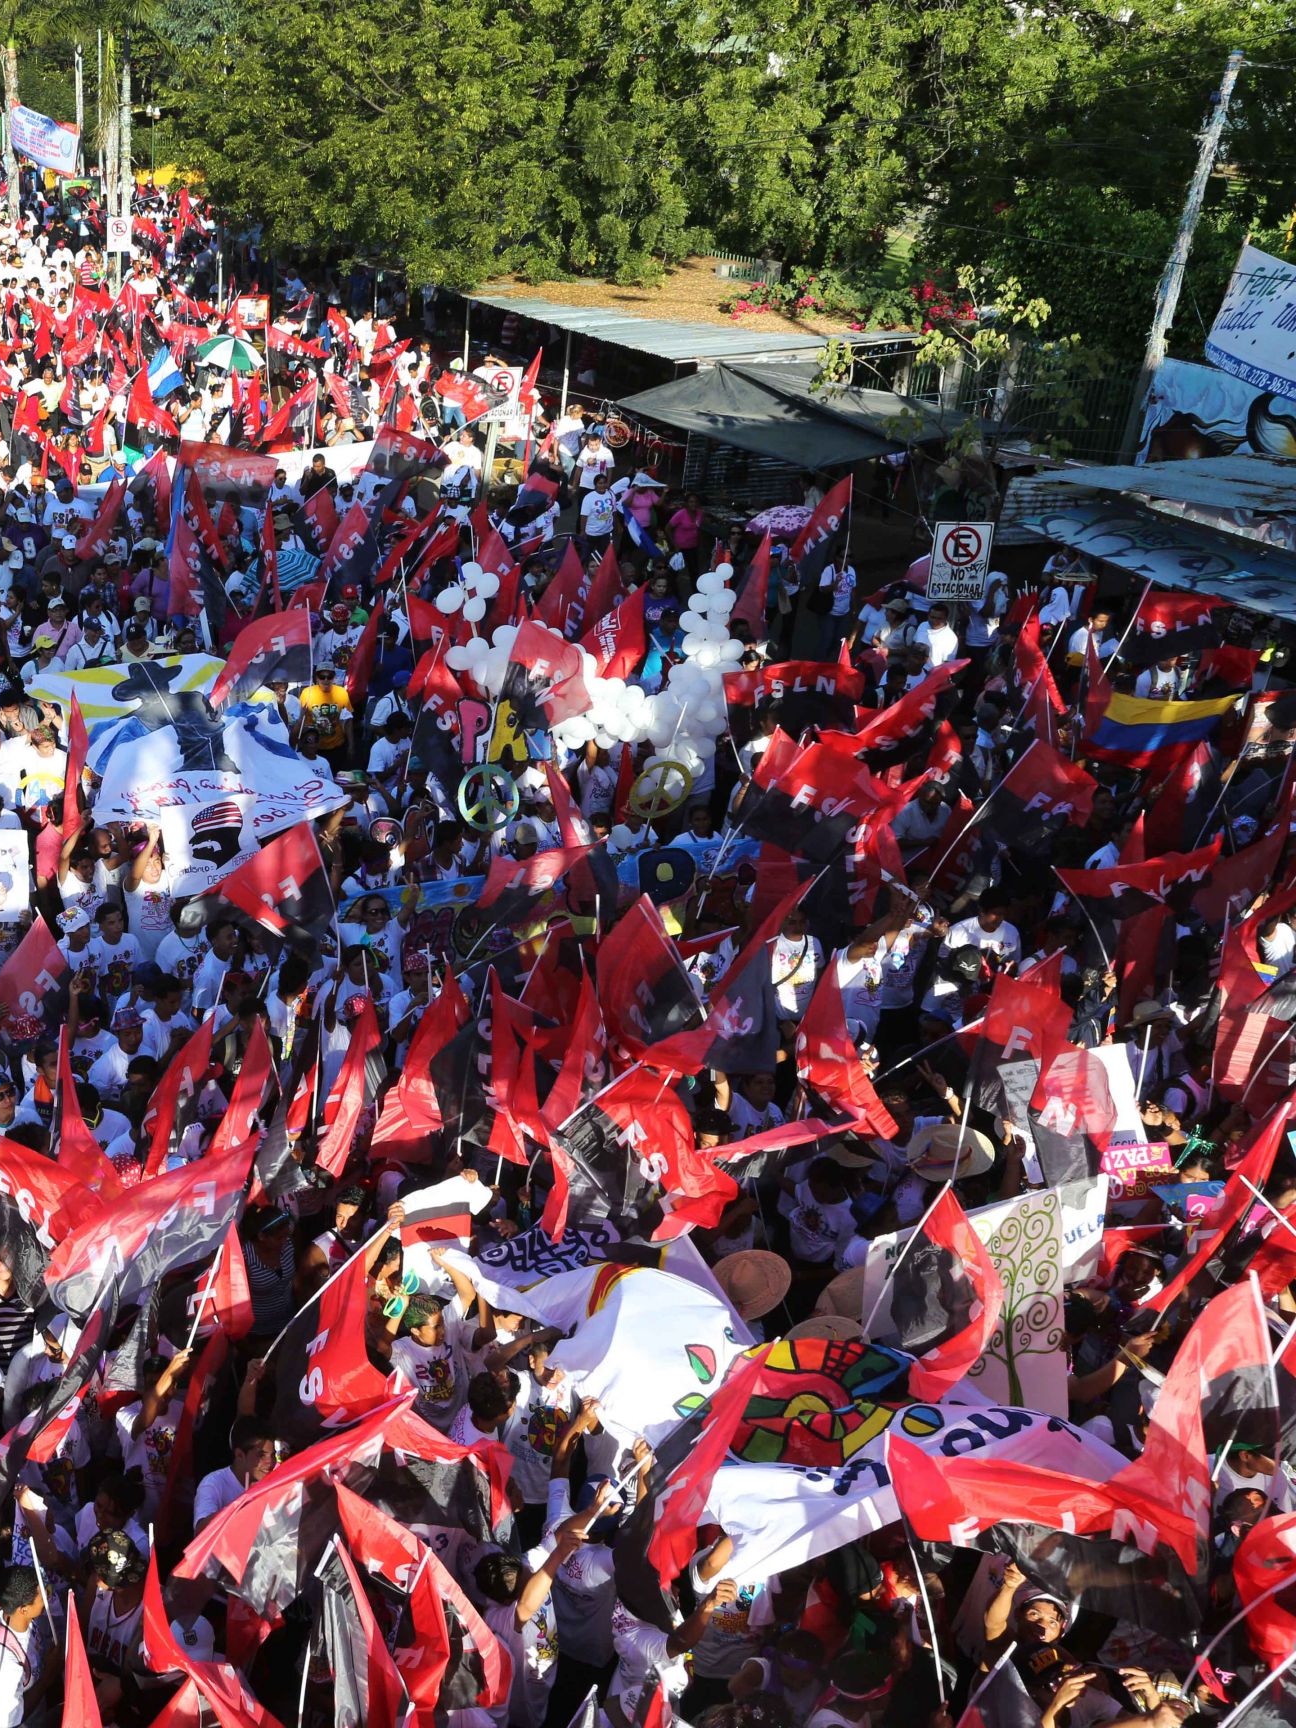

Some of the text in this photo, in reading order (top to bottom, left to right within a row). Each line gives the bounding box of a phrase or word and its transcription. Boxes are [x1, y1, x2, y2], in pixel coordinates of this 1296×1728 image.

[242, 402, 255, 437] SLN
[931, 582, 980, 594] ESTACIONAR
[950, 568, 965, 581] NO
[1136, 608, 1213, 640] FSLN
[754, 676, 836, 709] FSLN
[845, 822, 873, 905] SLN
[1104, 1145, 1150, 1171] PAZ!
